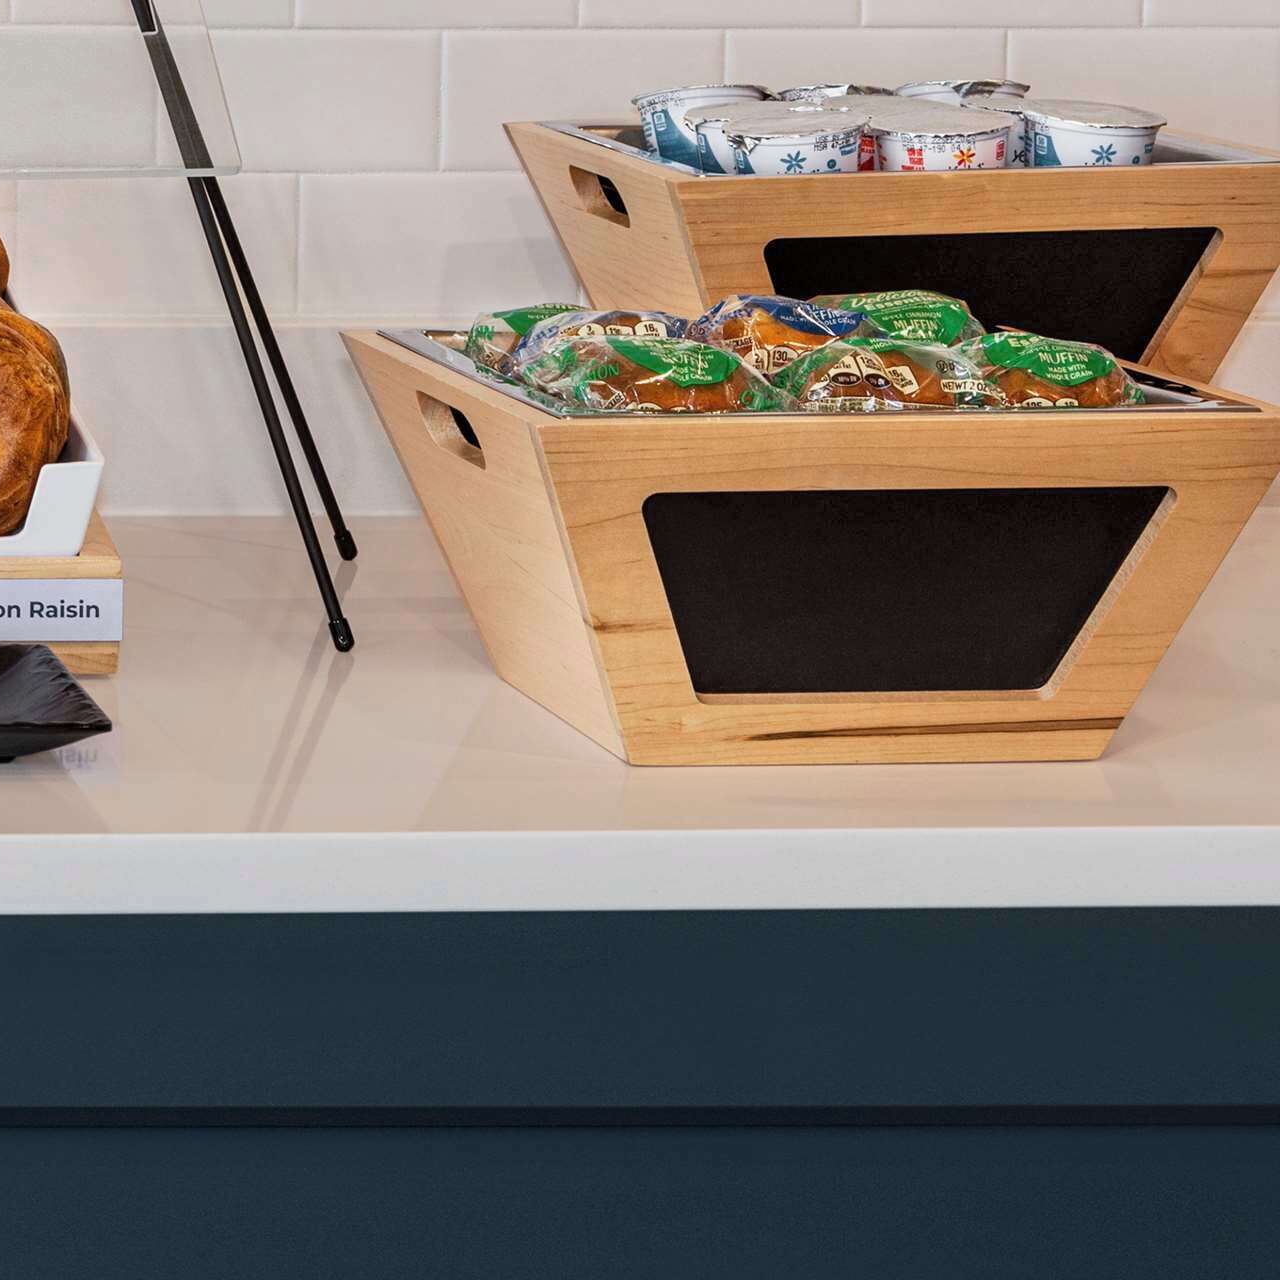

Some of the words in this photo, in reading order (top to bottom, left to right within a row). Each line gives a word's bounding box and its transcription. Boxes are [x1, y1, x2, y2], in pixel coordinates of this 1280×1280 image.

[1038, 351, 1089, 365] MUFFIN
[1067, 363, 1087, 371] WITH
[1046, 372, 1069, 381] WHOLE
[1070, 370, 1093, 380] GRAIN
[30, 600, 100, 619] Raisin
